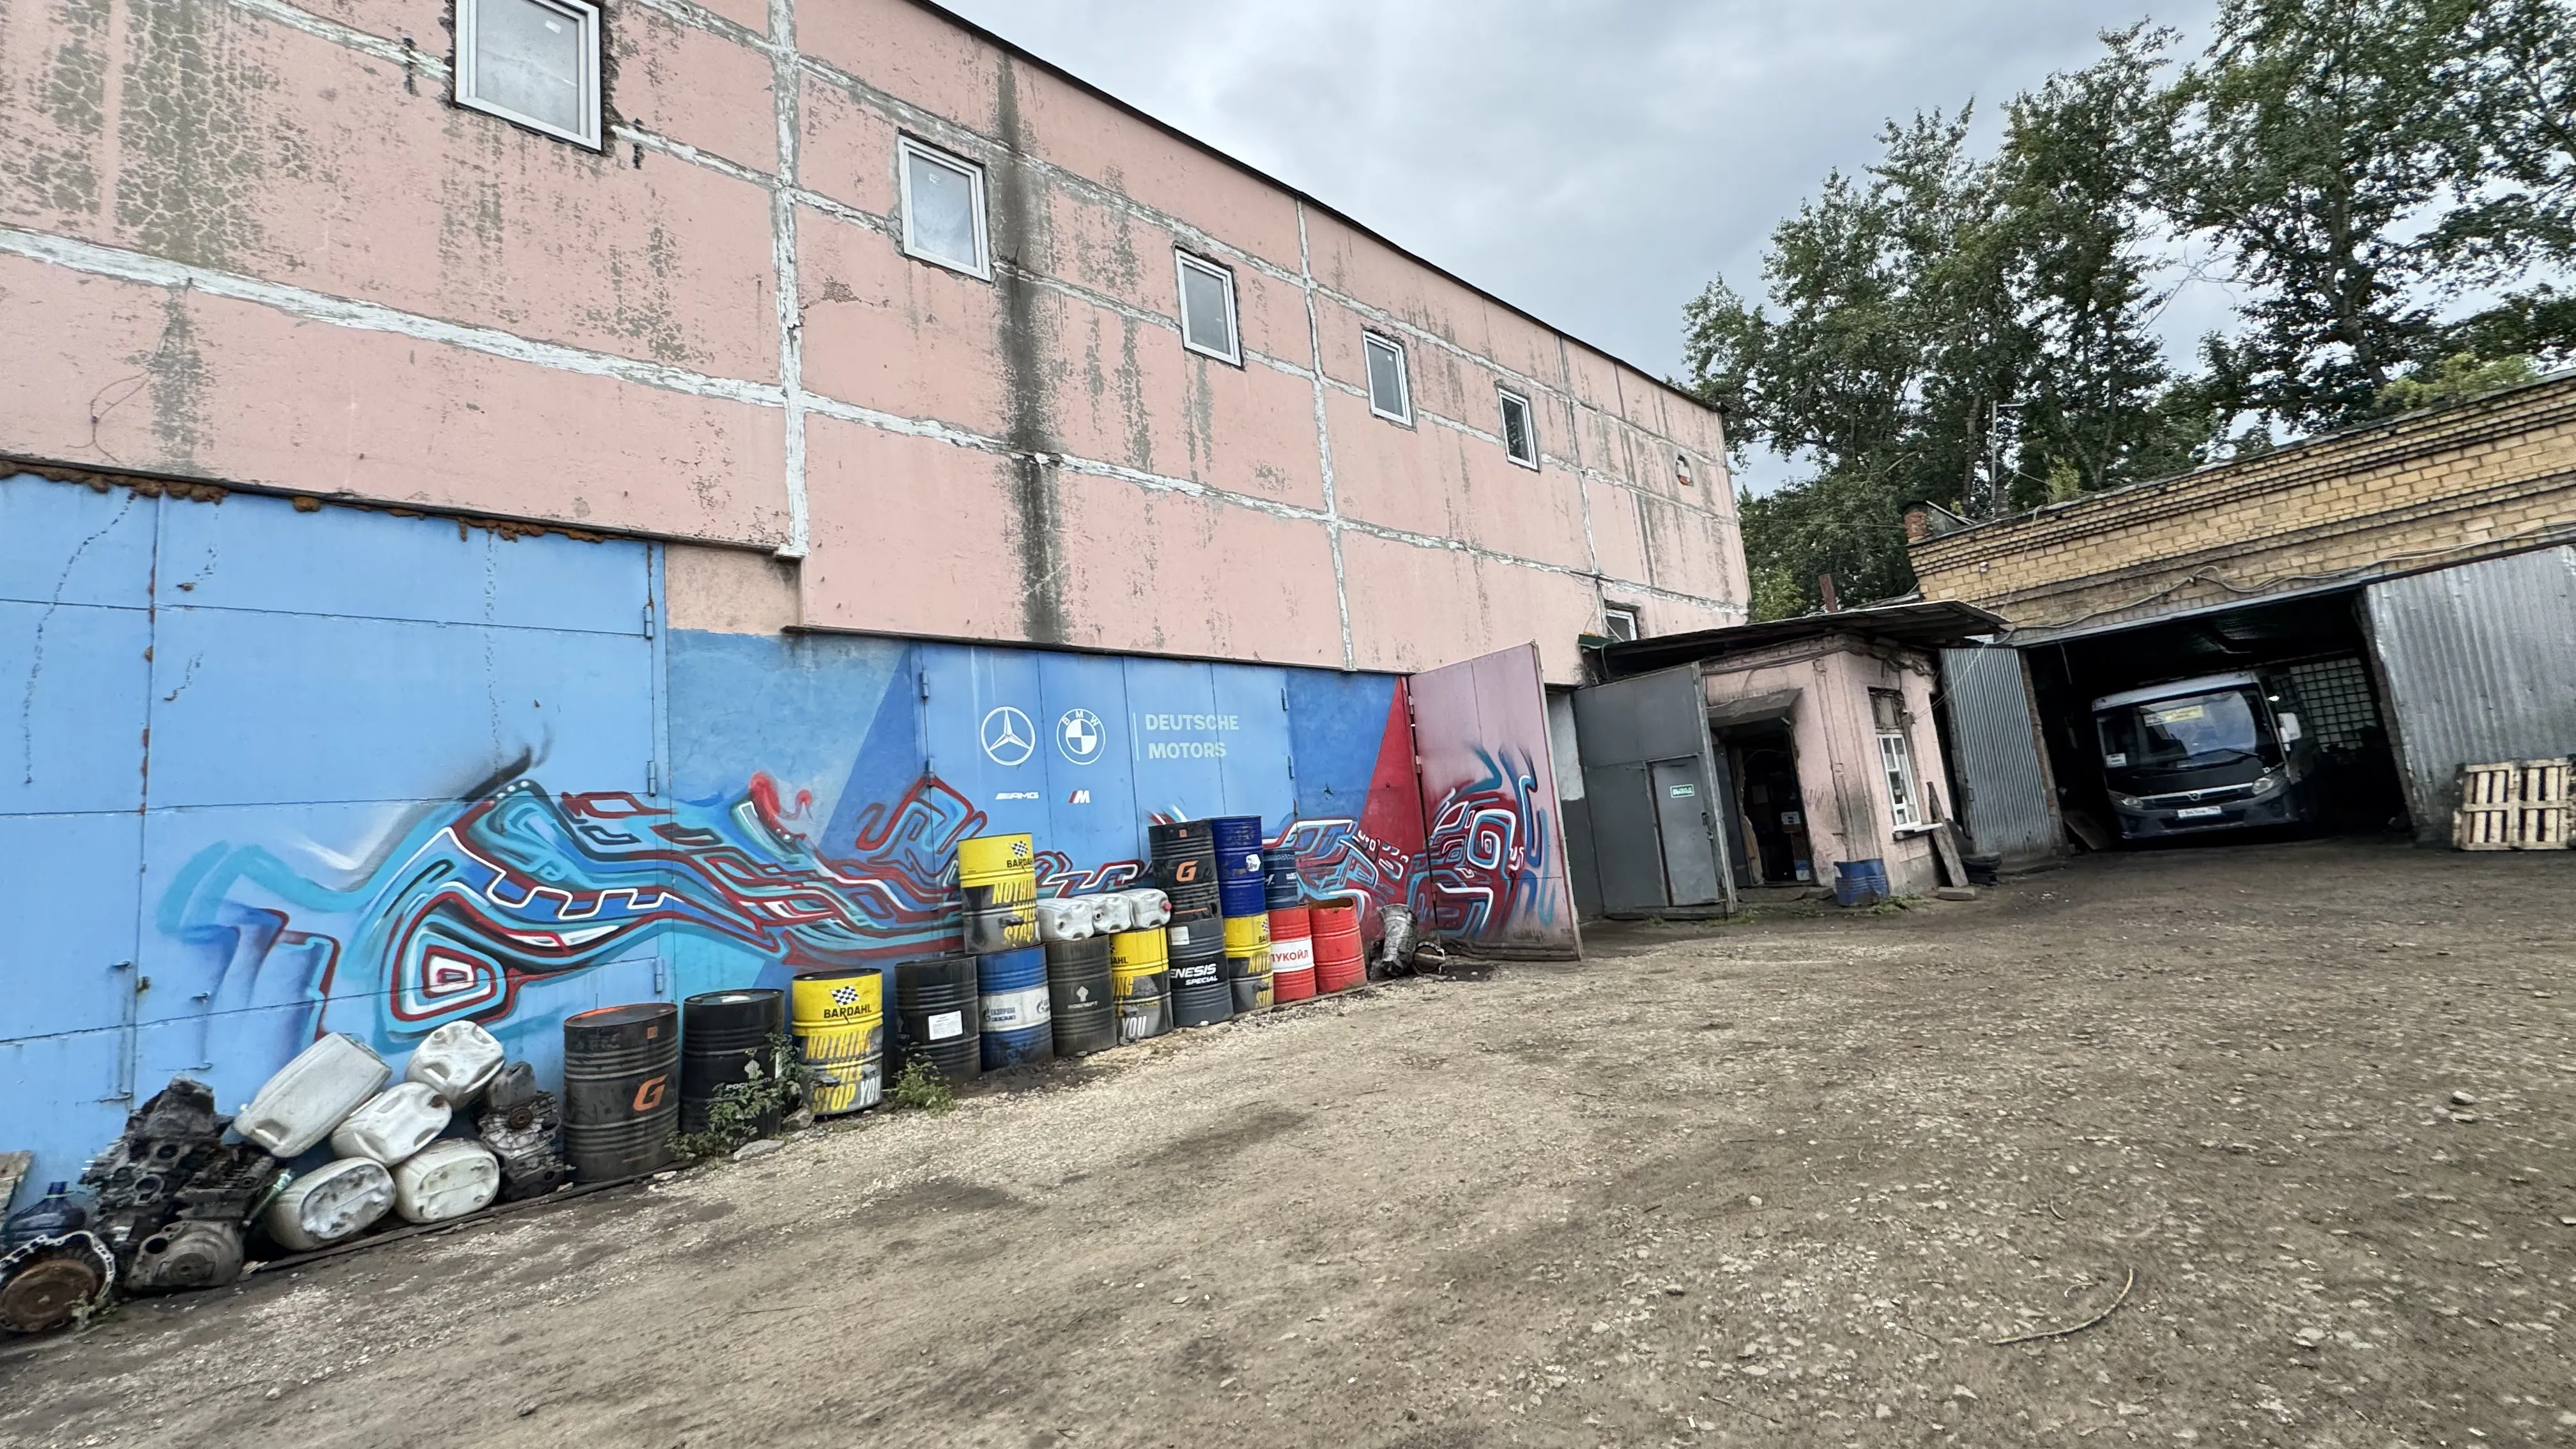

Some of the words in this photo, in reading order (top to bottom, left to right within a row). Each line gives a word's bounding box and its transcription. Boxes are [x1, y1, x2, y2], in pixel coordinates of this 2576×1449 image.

[1145, 714, 1239, 731] DEUTSCHE
[1148, 741, 1227, 759] MOTORS
[992, 879, 1037, 904] NOTHIN
[1271, 949, 1309, 963] ЛУКОЙЛ
[1170, 963, 1217, 979] ENESIS
[1185, 975, 1218, 986] SPECIAL
[824, 1004, 873, 1019] BARDAHL
[1121, 1015, 1147, 1038] YOU
[805, 1028, 872, 1060] NOTHING
[811, 1083, 856, 1114] STOP
[859, 1075, 882, 1107] YOU
